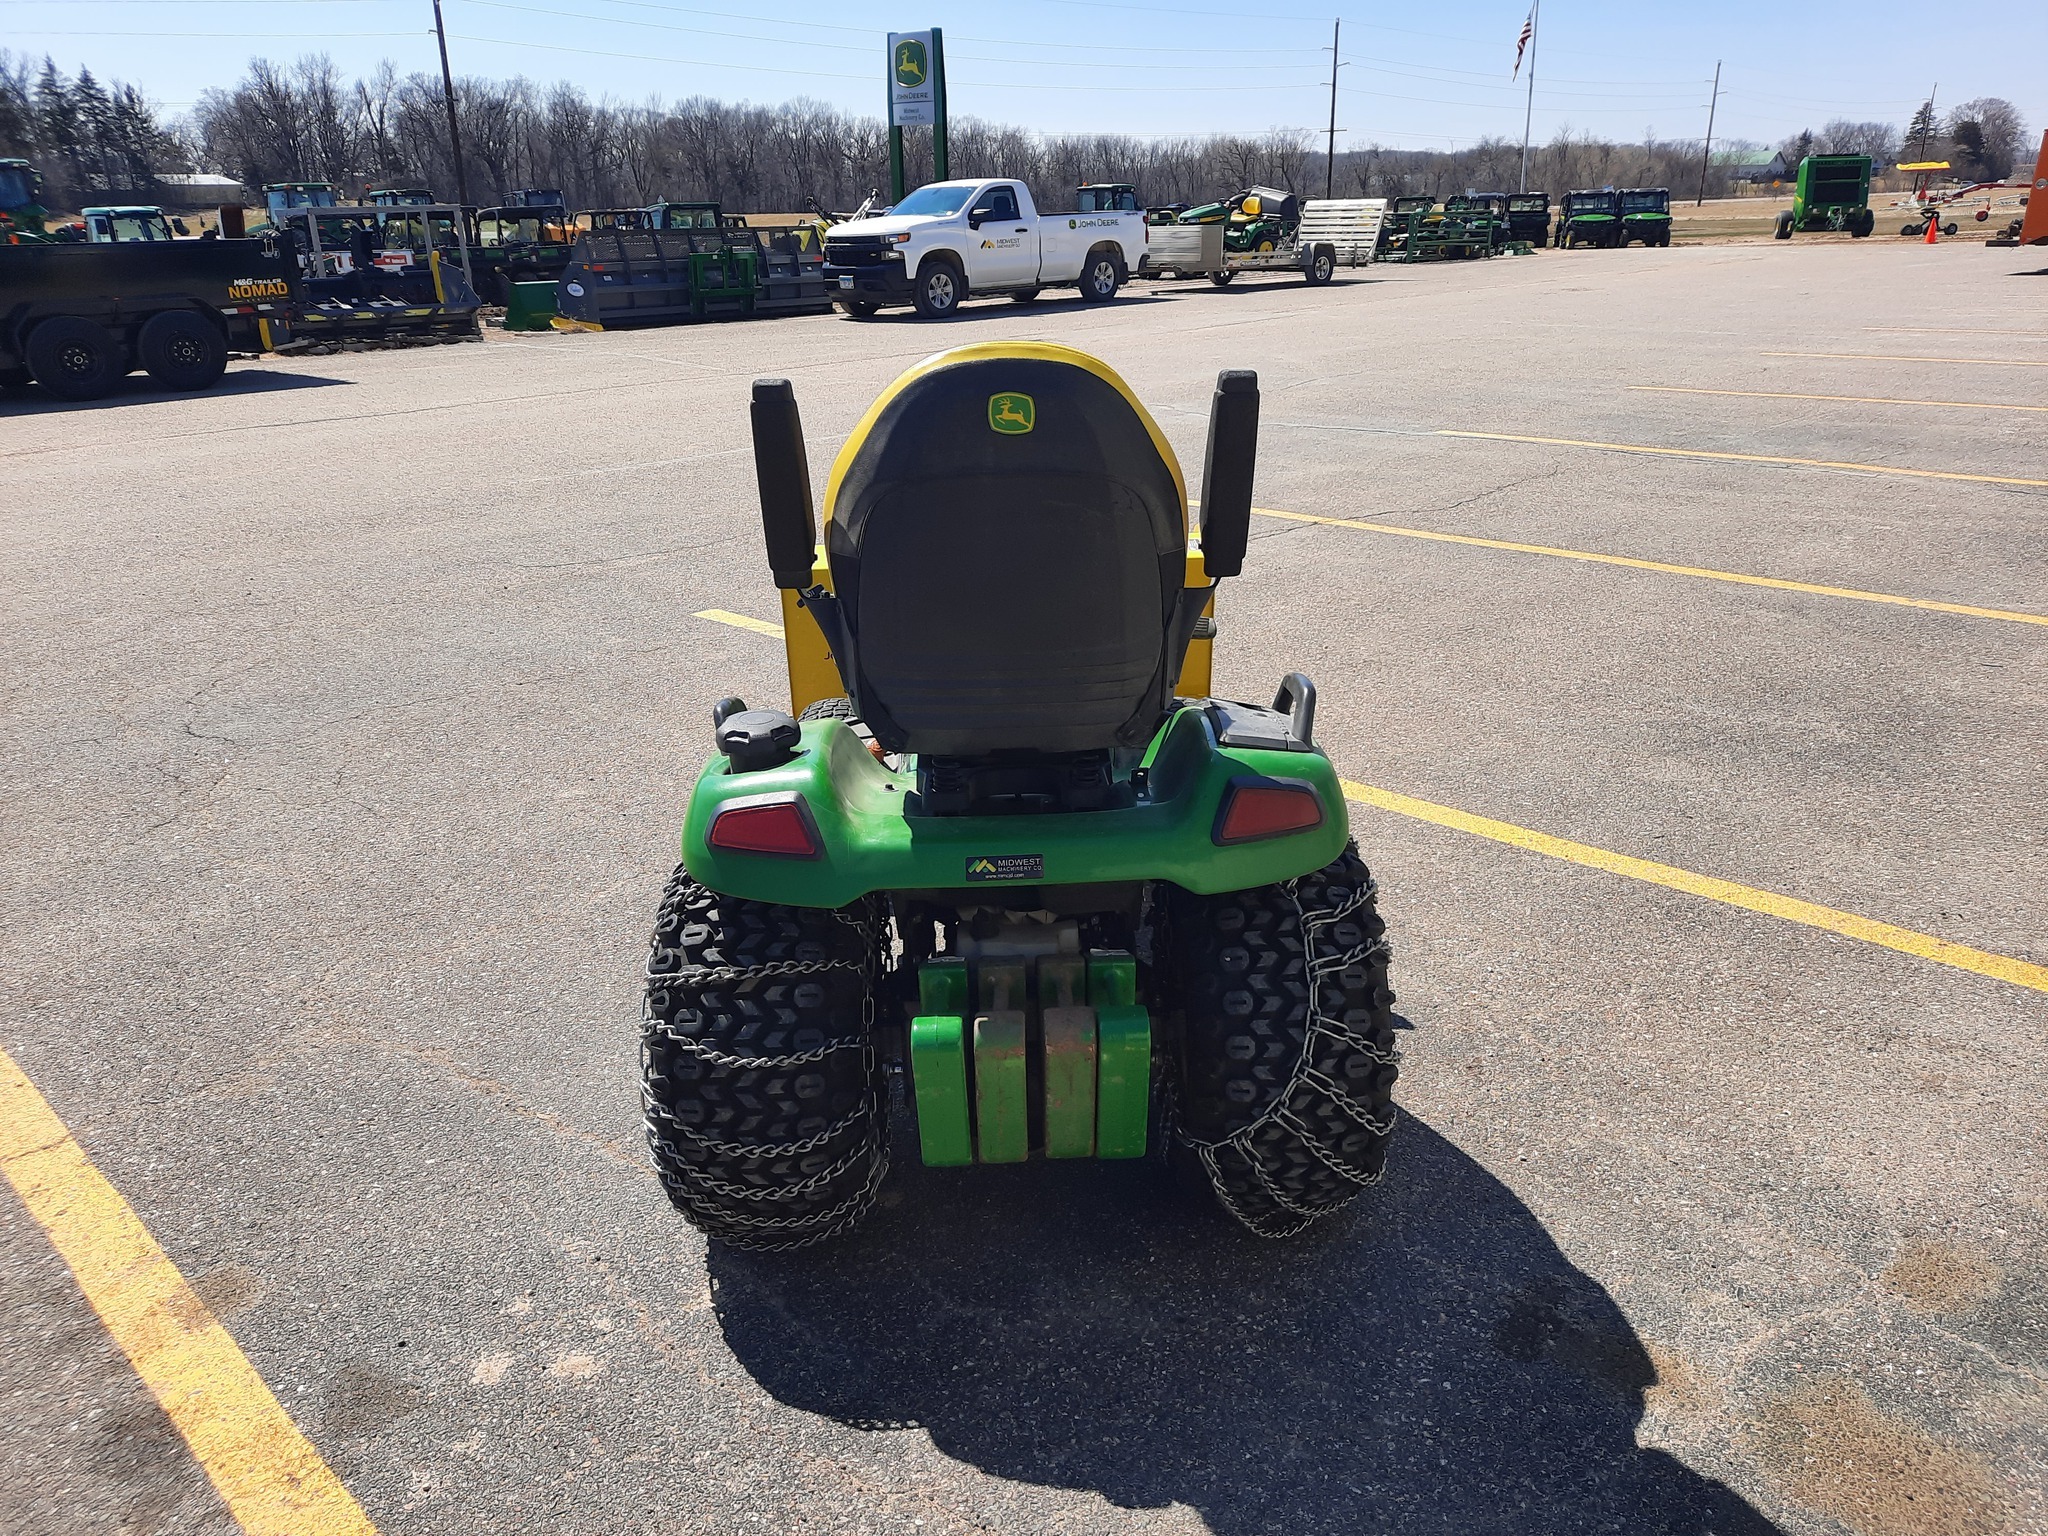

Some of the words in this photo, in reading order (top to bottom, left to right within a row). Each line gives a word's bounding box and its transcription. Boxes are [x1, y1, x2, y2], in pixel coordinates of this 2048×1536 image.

[1078, 220, 1096, 228] JOHN
[1097, 218, 1119, 227] DEERE
[233, 278, 253, 286] M&G
[228, 282, 288, 298] NOMAD
[997, 858, 1041, 867] MIDWEST
